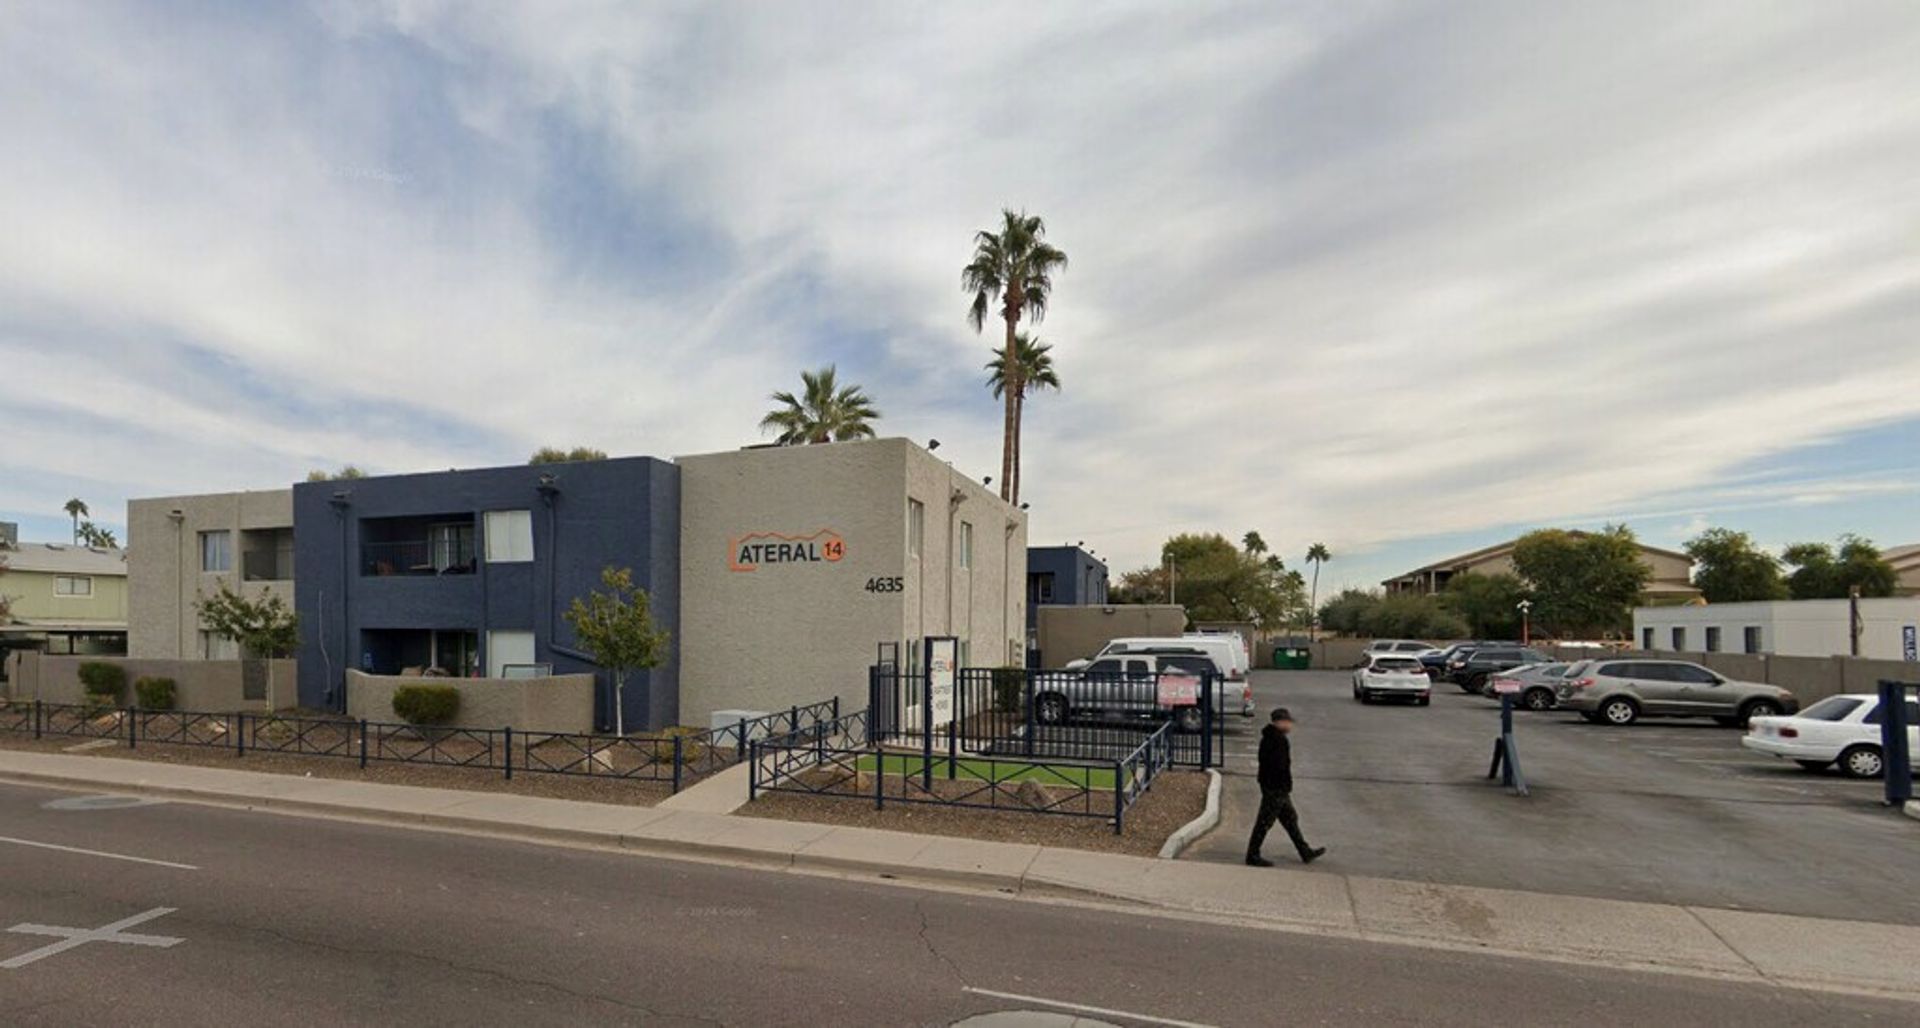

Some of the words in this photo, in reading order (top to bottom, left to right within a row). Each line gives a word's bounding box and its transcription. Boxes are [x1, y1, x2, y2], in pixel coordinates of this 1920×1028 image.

[729, 537, 821, 571] LATERAL
[824, 541, 843, 557] 14
[865, 577, 904, 593] 4635
